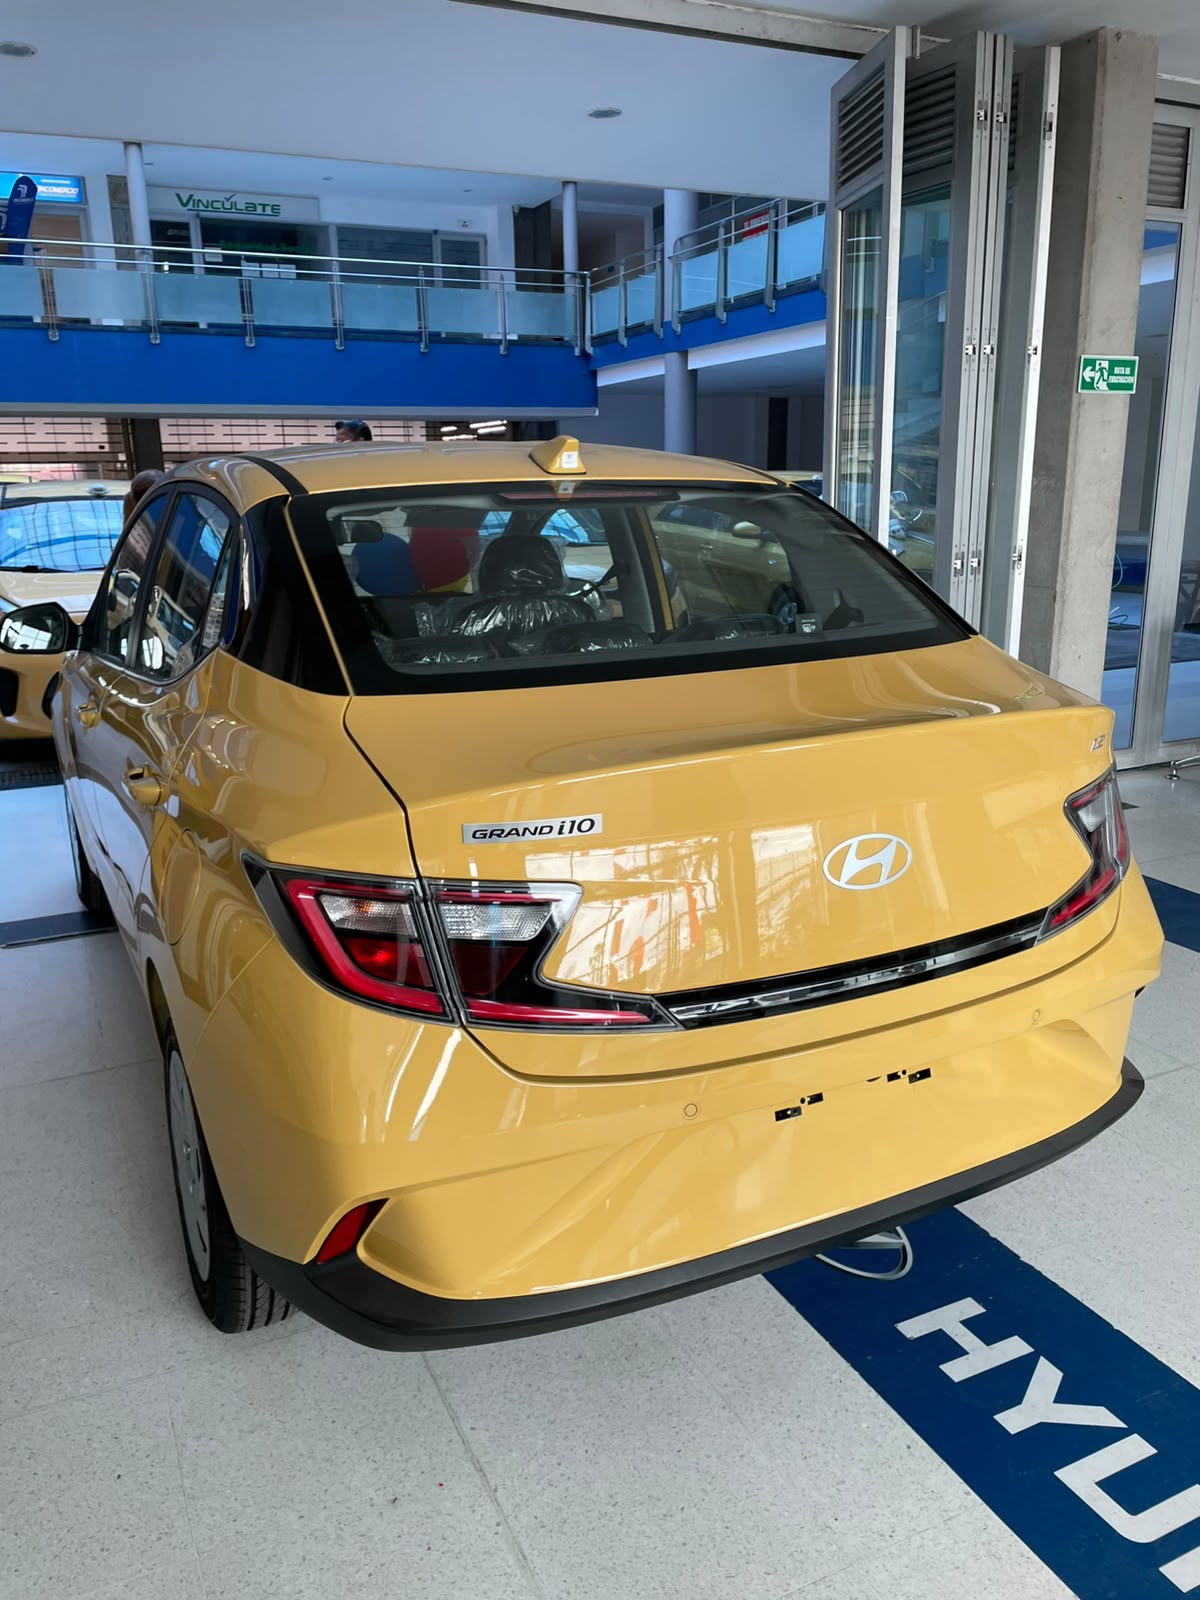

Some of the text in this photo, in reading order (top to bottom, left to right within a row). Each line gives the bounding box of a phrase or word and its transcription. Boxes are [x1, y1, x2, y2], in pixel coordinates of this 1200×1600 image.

[471, 818, 596, 840] GRAND i10
[894, 1296, 1200, 1594] HYU
